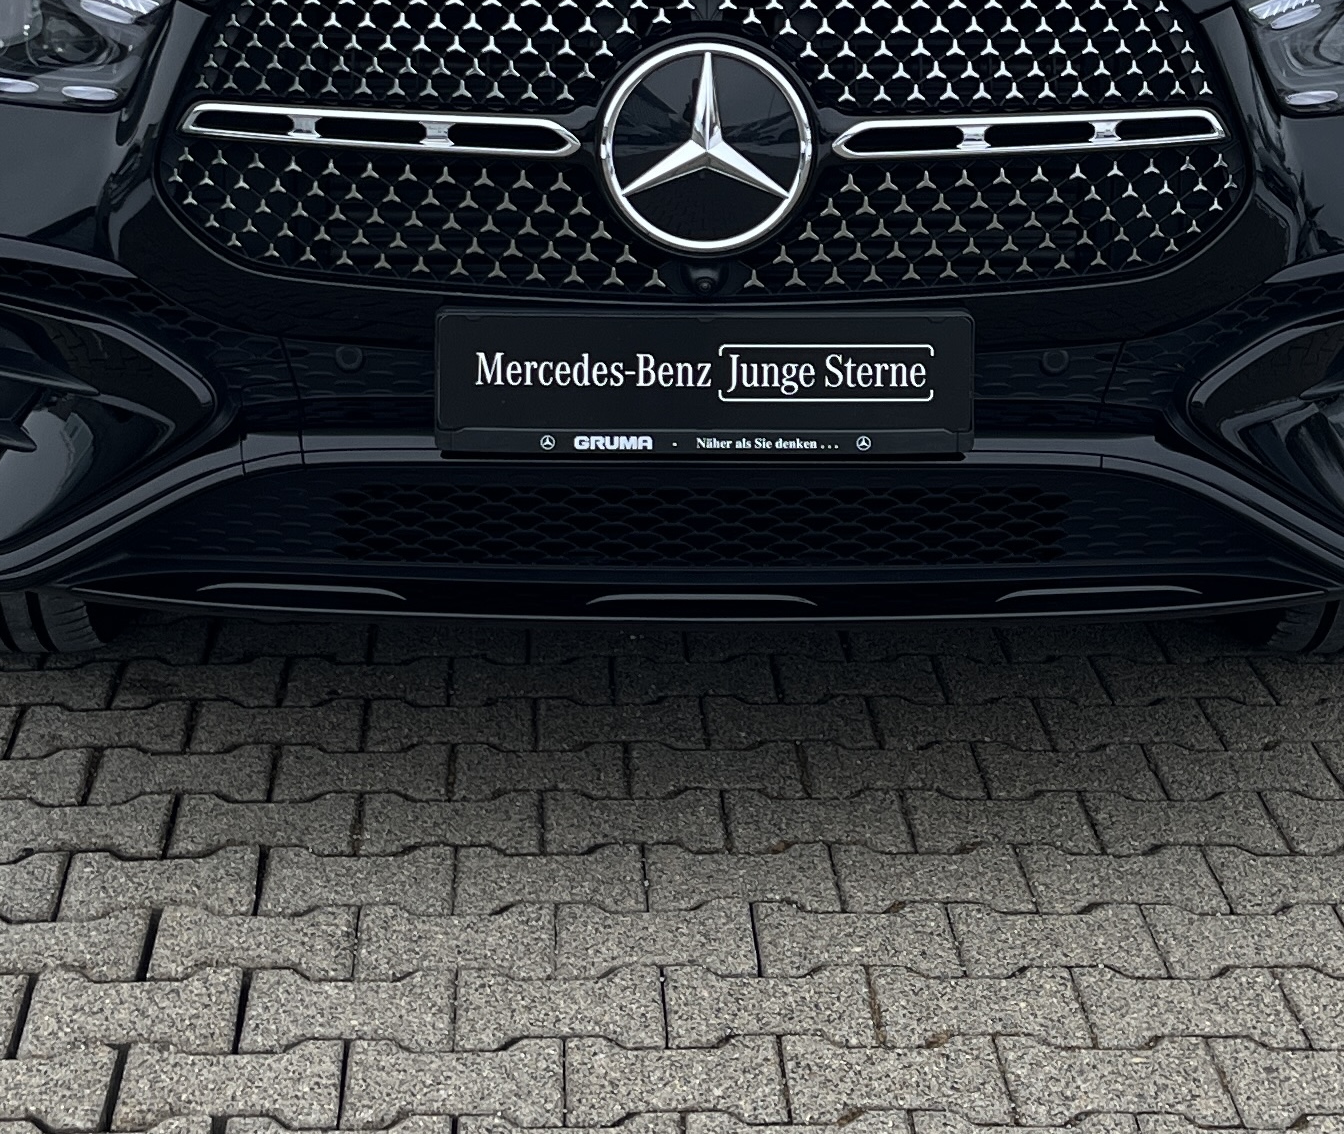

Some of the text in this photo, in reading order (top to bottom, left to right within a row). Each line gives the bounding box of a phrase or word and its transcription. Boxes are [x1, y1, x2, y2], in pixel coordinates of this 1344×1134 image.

[474, 351, 927, 396] Mercedes-Benz Junge Sterne
[573, 435, 653, 451] GRUMA
[696, 437, 733, 449] Näher
[735, 437, 752, 449] als
[754, 437, 773, 449] Sie
[774, 437, 818, 449] denken
